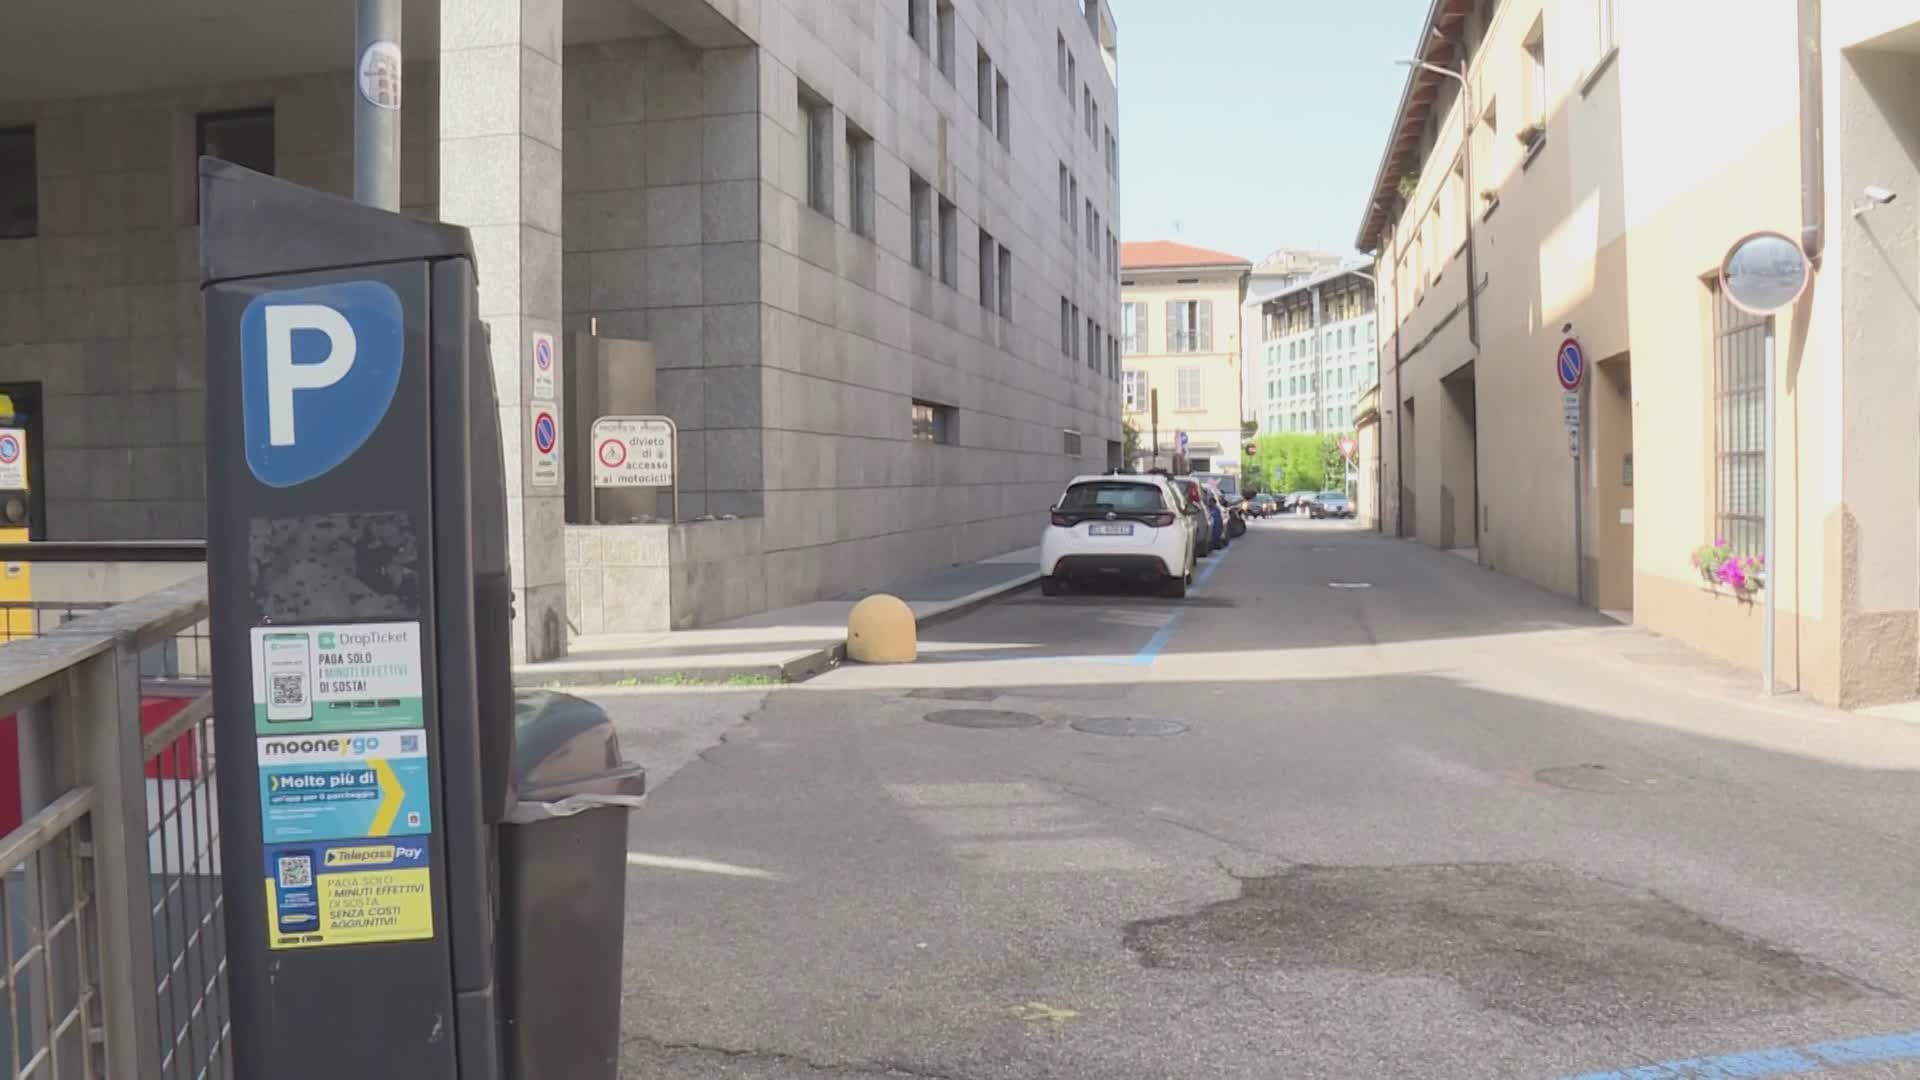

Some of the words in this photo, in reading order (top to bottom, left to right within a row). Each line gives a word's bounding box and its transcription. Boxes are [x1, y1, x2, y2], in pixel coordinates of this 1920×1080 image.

[265, 305, 357, 446] P
[629, 437, 665, 446] divieto
[642, 449, 652, 458] di
[626, 461, 668, 469] accesso
[603, 475, 613, 483] ai
[340, 631, 408, 647] DropTicket
[319, 653, 344, 665] PAGA
[346, 651, 372, 664] SOLO
[320, 681, 330, 693] DI
[332, 680, 367, 692] SOSTA!
[281, 774, 326, 788] Molto
[329, 771, 355, 787] più
[359, 770, 375, 784] di
[340, 850, 393, 861] Telepass
[396, 847, 422, 859] Pay
[334, 886, 373, 897] MINUTI
[376, 883, 425, 895] EFFETTIVI
[330, 908, 365, 920] SENZA
[368, 906, 401, 916] COSTI
